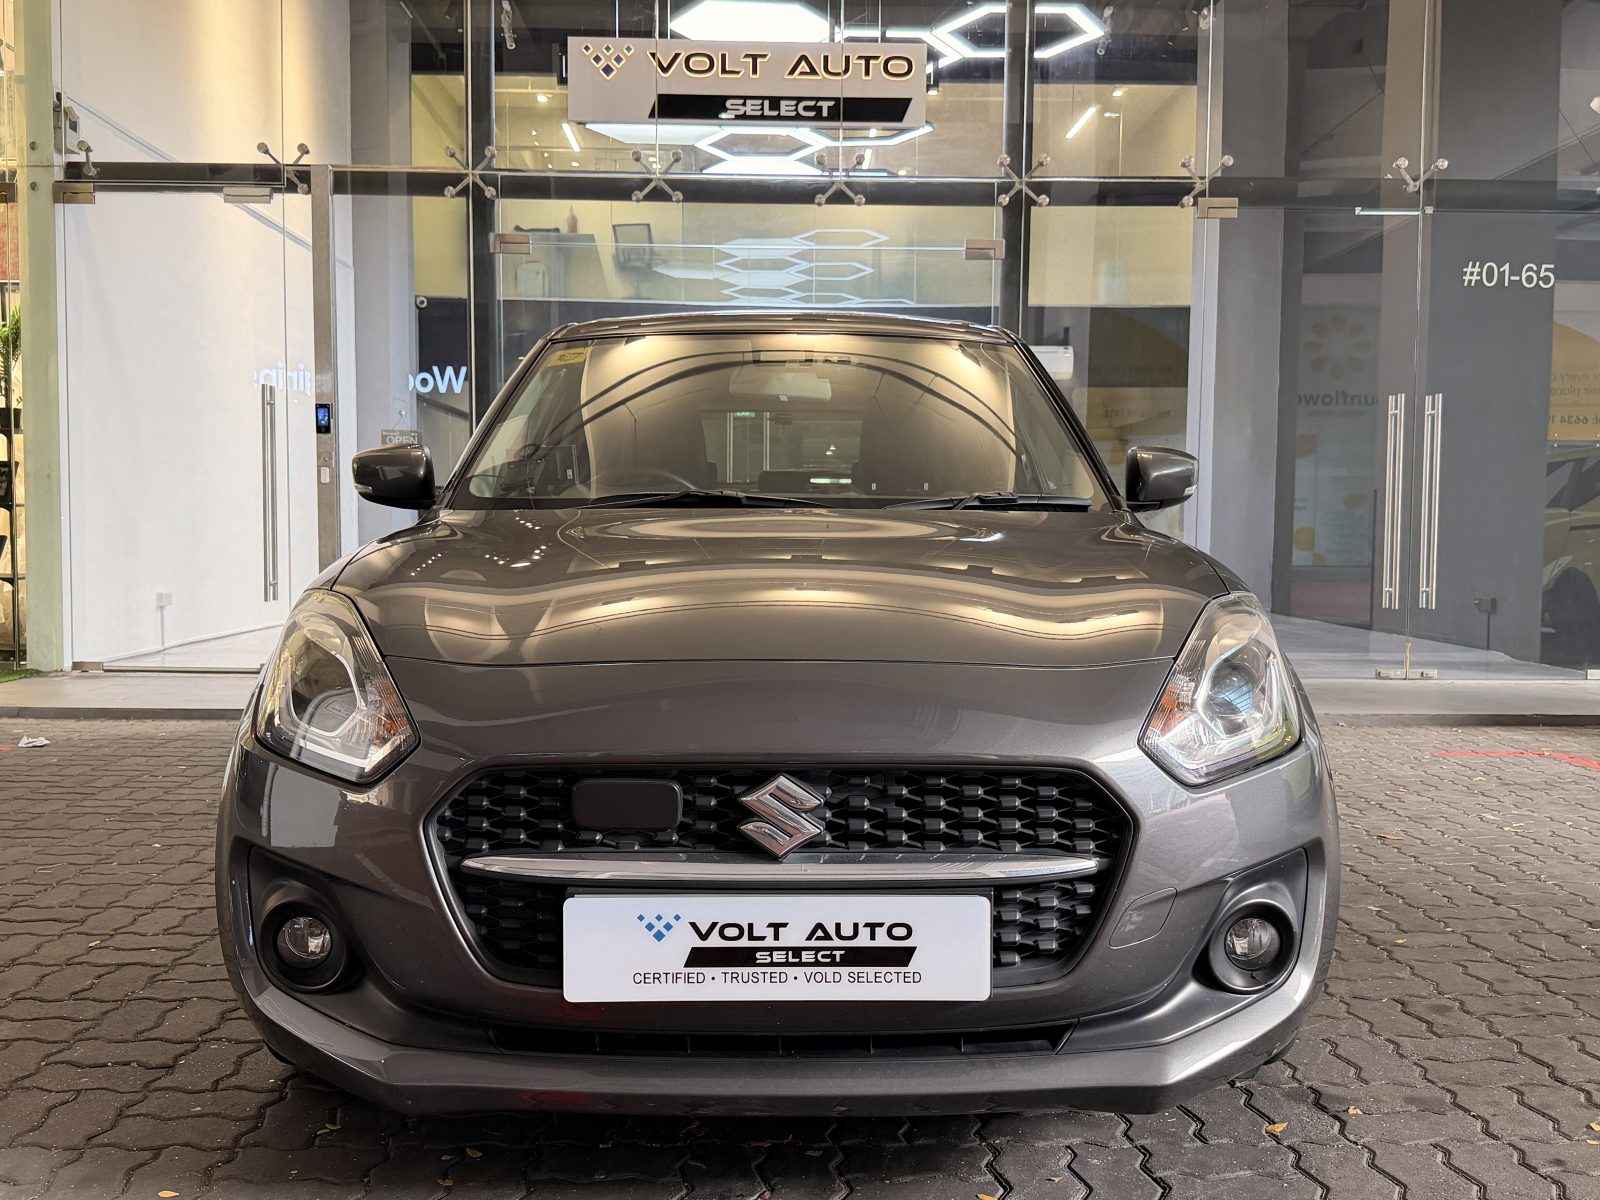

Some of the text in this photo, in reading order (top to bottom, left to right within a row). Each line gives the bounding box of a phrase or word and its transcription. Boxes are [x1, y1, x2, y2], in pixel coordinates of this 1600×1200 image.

[647, 50, 914, 81] VOLT AUTO
[725, 99, 836, 118] SELECT
[1462, 261, 1555, 289] #01-65
[688, 921, 913, 941] VOLT AUTO
[755, 950, 846, 964] SELECT
[633, 971, 922, 985] CERTIFIED TRUSTED VOLD SELECTED
